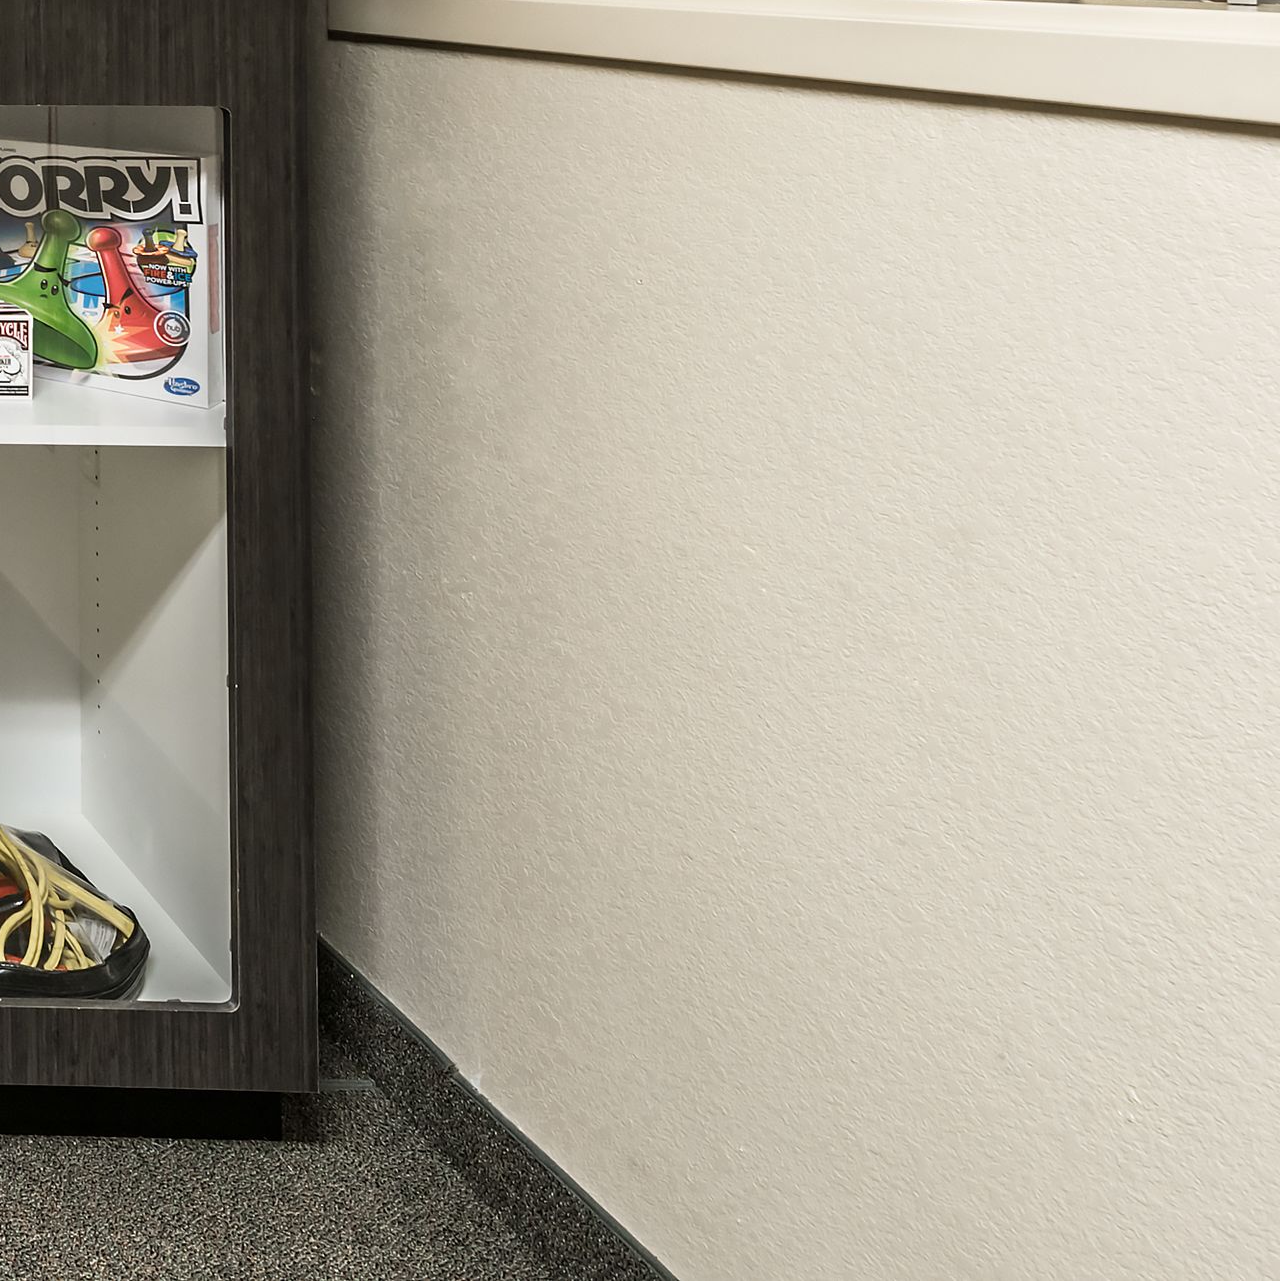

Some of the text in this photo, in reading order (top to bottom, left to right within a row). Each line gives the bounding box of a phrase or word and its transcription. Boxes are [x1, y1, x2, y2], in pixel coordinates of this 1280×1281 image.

[148, 263, 167, 271] NOW
[143, 269, 192, 282] FIRE & ICE
[166, 323, 181, 333] hub
